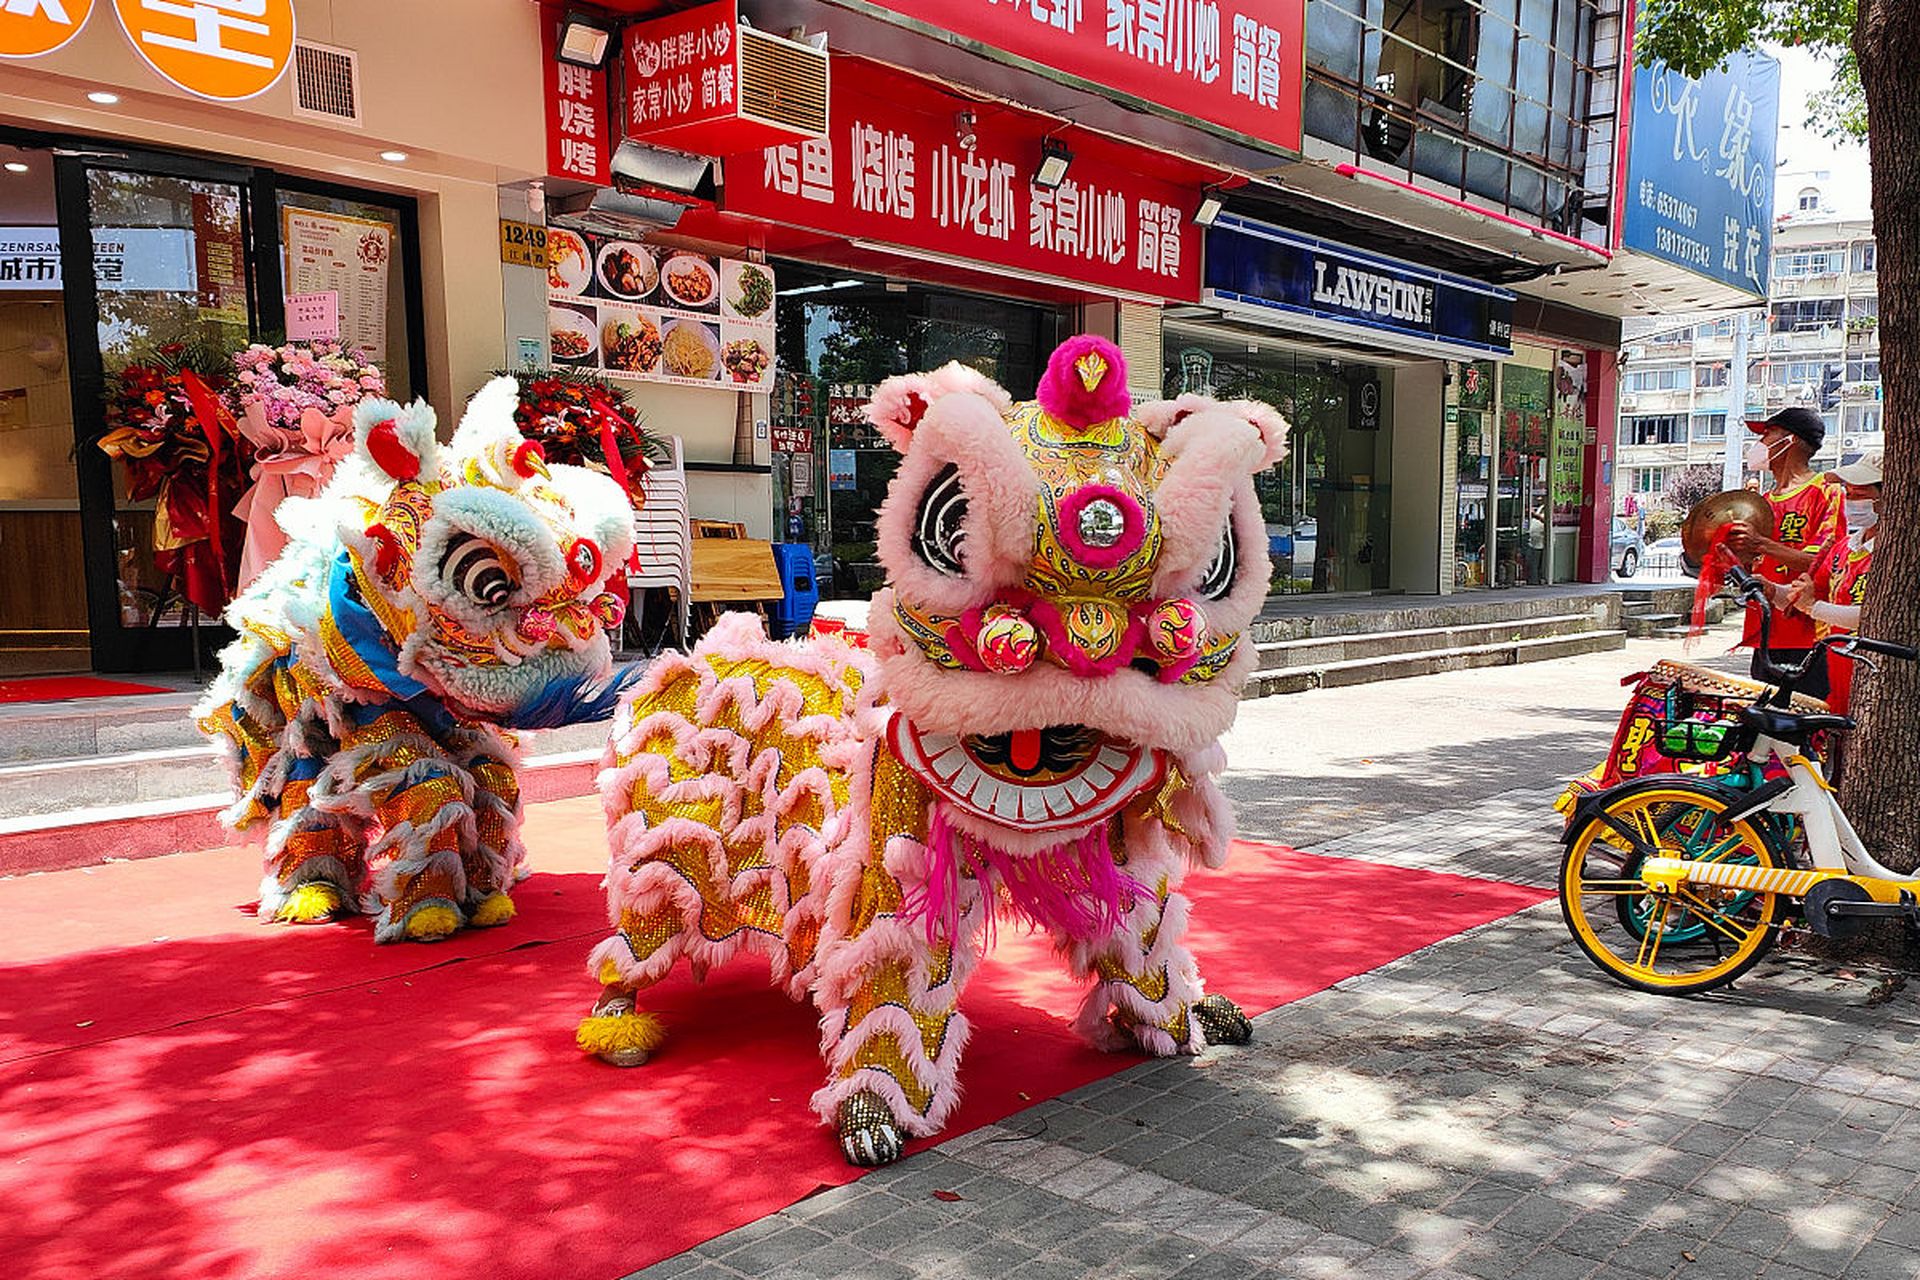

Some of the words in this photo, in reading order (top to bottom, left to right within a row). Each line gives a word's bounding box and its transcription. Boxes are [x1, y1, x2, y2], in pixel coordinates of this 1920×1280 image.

[661, 21, 731, 71] 胖胖小炒
[1232, 13, 1281, 110] 简餐
[633, 72, 693, 124] 家常小炒
[701, 63, 734, 109] 简餐
[851, 121, 915, 220] 烧烤
[931, 143, 1016, 241] 小龙虾
[1029, 177, 1126, 265] 家常小炒
[1137, 199, 1182, 278] 简餐
[505, 224, 546, 248] 1249
[1723, 215, 1765, 295] 洗衣
[1313, 260, 1425, 323] LAWSON
